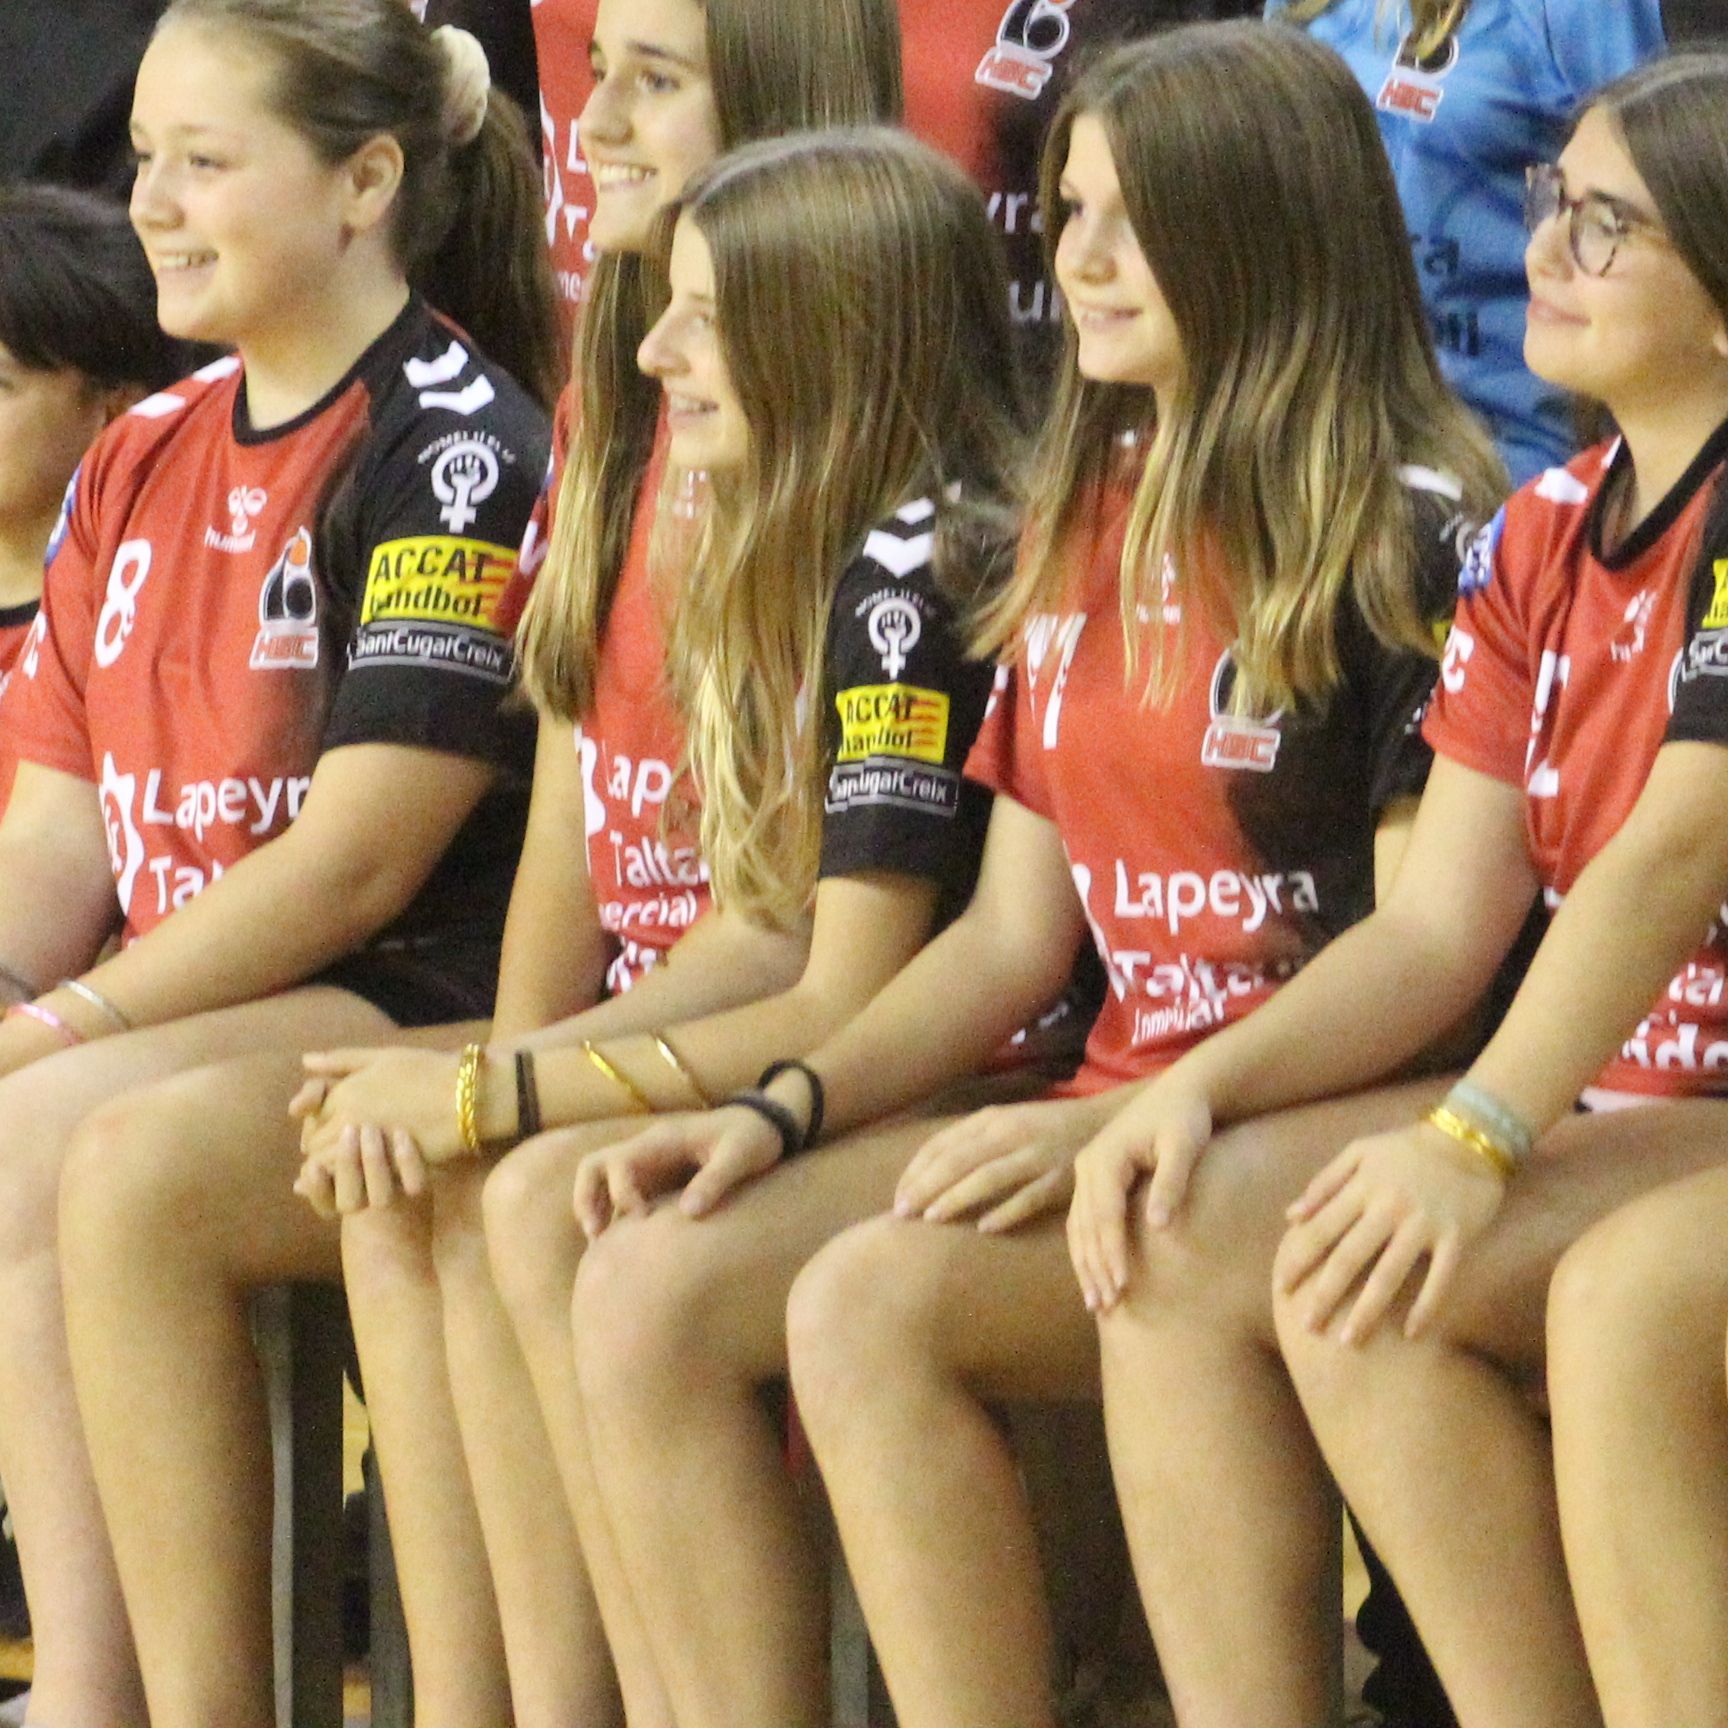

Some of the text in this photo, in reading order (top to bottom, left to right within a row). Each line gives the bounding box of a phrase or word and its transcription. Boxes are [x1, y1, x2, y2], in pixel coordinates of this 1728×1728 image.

[94, 537, 153, 669] 8
[372, 543, 496, 585] ACCAT
[1114, 858, 1320, 936] Lapeyra
